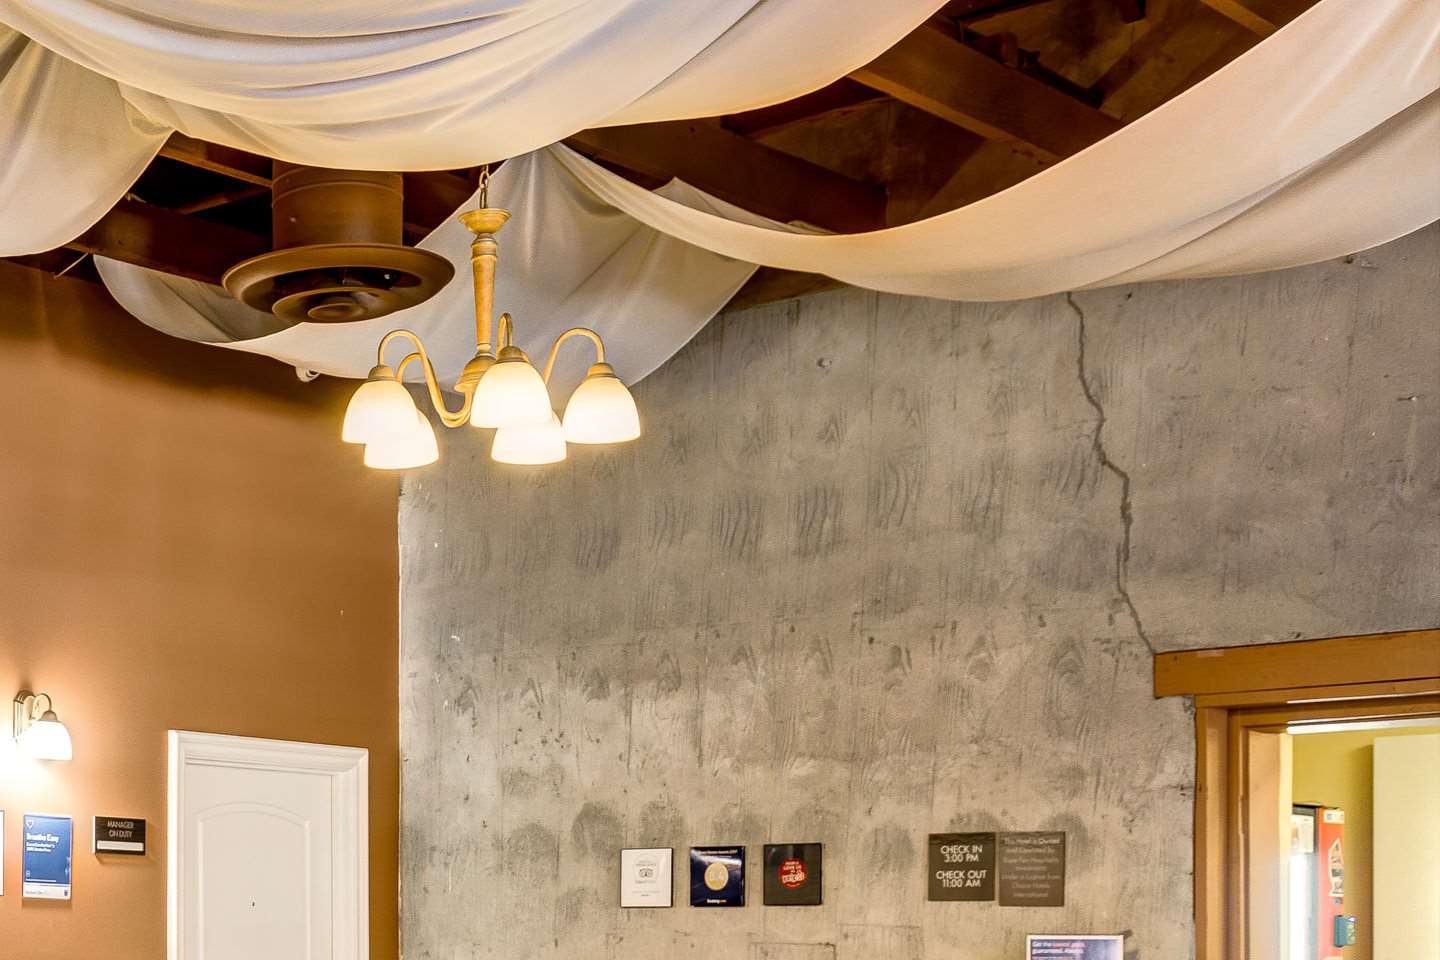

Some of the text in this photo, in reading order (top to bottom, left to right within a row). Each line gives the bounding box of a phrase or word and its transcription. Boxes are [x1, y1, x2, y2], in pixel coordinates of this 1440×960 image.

[107, 820, 134, 829] MANAGER
[109, 830, 134, 839] ON DUTY
[940, 844, 984, 854] CHECK IN
[943, 853, 979, 863] 3:00 PM
[935, 869, 987, 880] CHECK OUT
[942, 879, 982, 888] 11:00 AM
